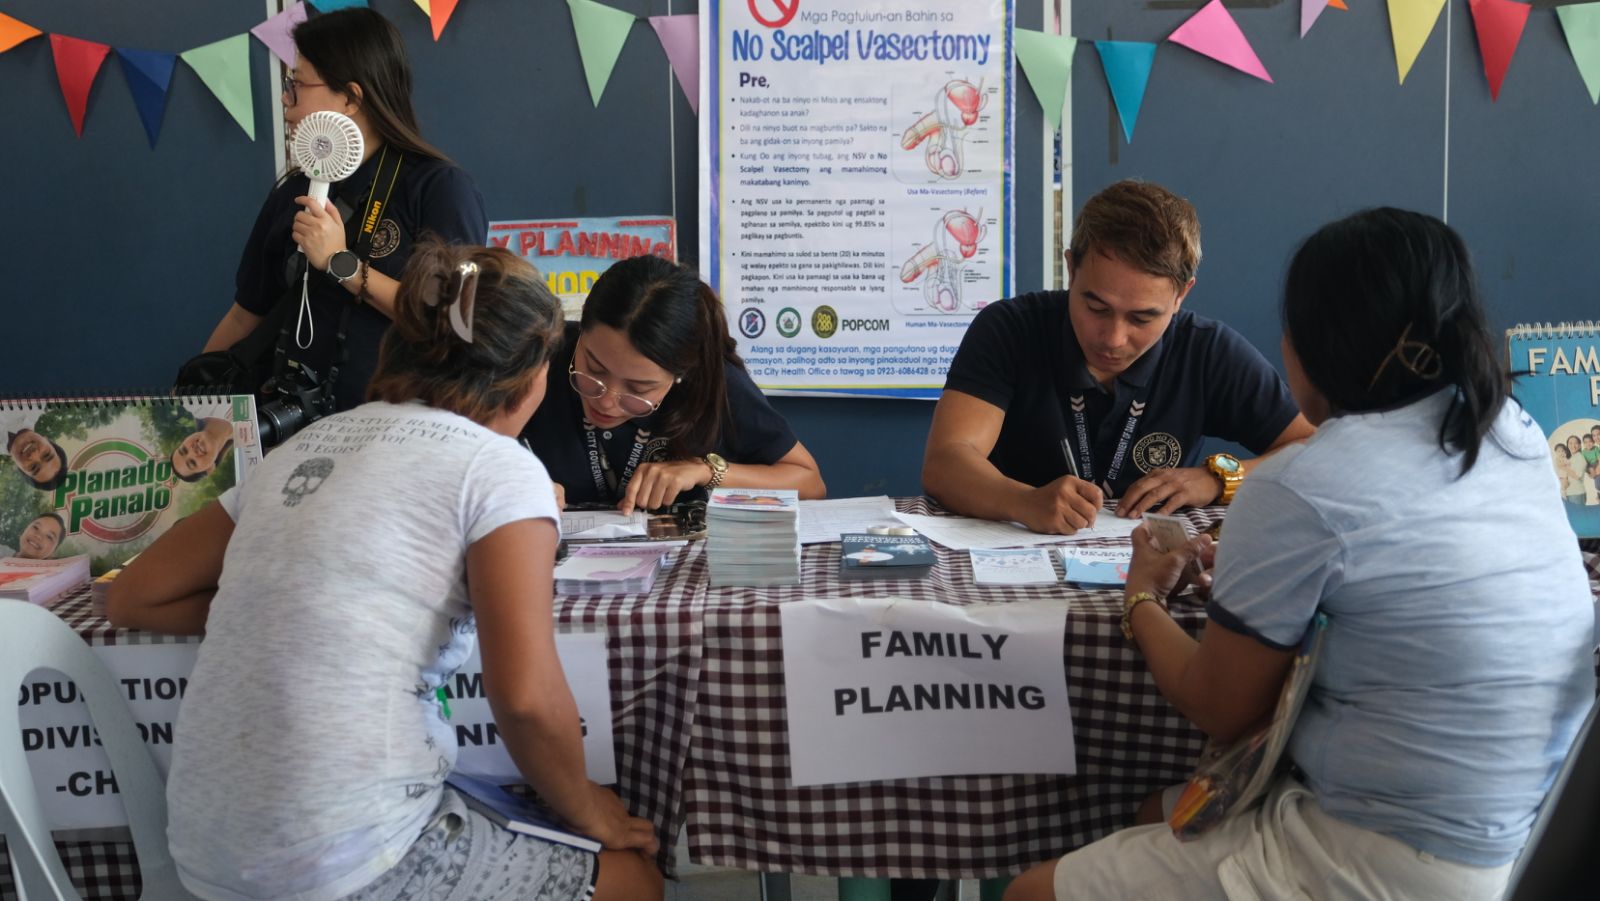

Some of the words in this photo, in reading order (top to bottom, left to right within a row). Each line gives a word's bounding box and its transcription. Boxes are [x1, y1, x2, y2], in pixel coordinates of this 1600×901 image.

[801, 11, 828, 24] Mga
[831, 10, 902, 24] Pagtulun-an
[906, 10, 938, 22] Bahin
[940, 12, 954, 22] sa
[732, 29, 764, 61] No
[770, 29, 849, 65] Scalpel
[856, 29, 991, 65] Vasectomy
[740, 72, 770, 88] Pre,
[740, 96, 770, 104] Nakab-ot
[792, 96, 811, 105] ninyo
[821, 96, 838, 104] Misis
[740, 109, 780, 118] kadaghanon
[762, 124, 781, 133] ninyo
[846, 124, 858, 133] pa?
[763, 137, 791, 146] gidak-on
[801, 137, 823, 146] inyong
[740, 152, 757, 161] Kung
[759, 152, 770, 160] Oo
[787, 152, 810, 161] inyong
[852, 152, 866, 160] NSV
[877, 152, 888, 160] No
[740, 166, 764, 174] Scalpel
[773, 166, 810, 174] Vasectomy
[841, 166, 887, 174] mamahimong
[740, 179, 781, 187] makatabang
[740, 198, 752, 206] Ang
[796, 198, 832, 206] permanente
[363, 201, 382, 234] Nikon
[842, 319, 890, 331] POPCOM
[750, 345, 774, 355] Alang
[786, 345, 817, 355] dugang
[863, 347, 881, 355] mga
[883, 345, 926, 355] pangutana
[927, 347, 938, 355] ug
[786, 356, 816, 366] palihog
[848, 356, 875, 366] inyong
[922, 358, 938, 366] nga
[1528, 346, 1600, 376] FAM
[764, 367, 779, 376] City
[781, 367, 806, 375] Health
[808, 367, 830, 375] Office
[840, 367, 864, 376] tawag
[586, 431, 597, 449] CITY
[628, 442, 644, 467] DAVAO
[54, 458, 178, 509] Planado,
[69, 486, 171, 533] Panalo
[861, 631, 1009, 660] FAMILY
[834, 684, 1046, 716] PLANNING
[22, 722, 173, 751] DIVION
[56, 770, 121, 797] -CH
